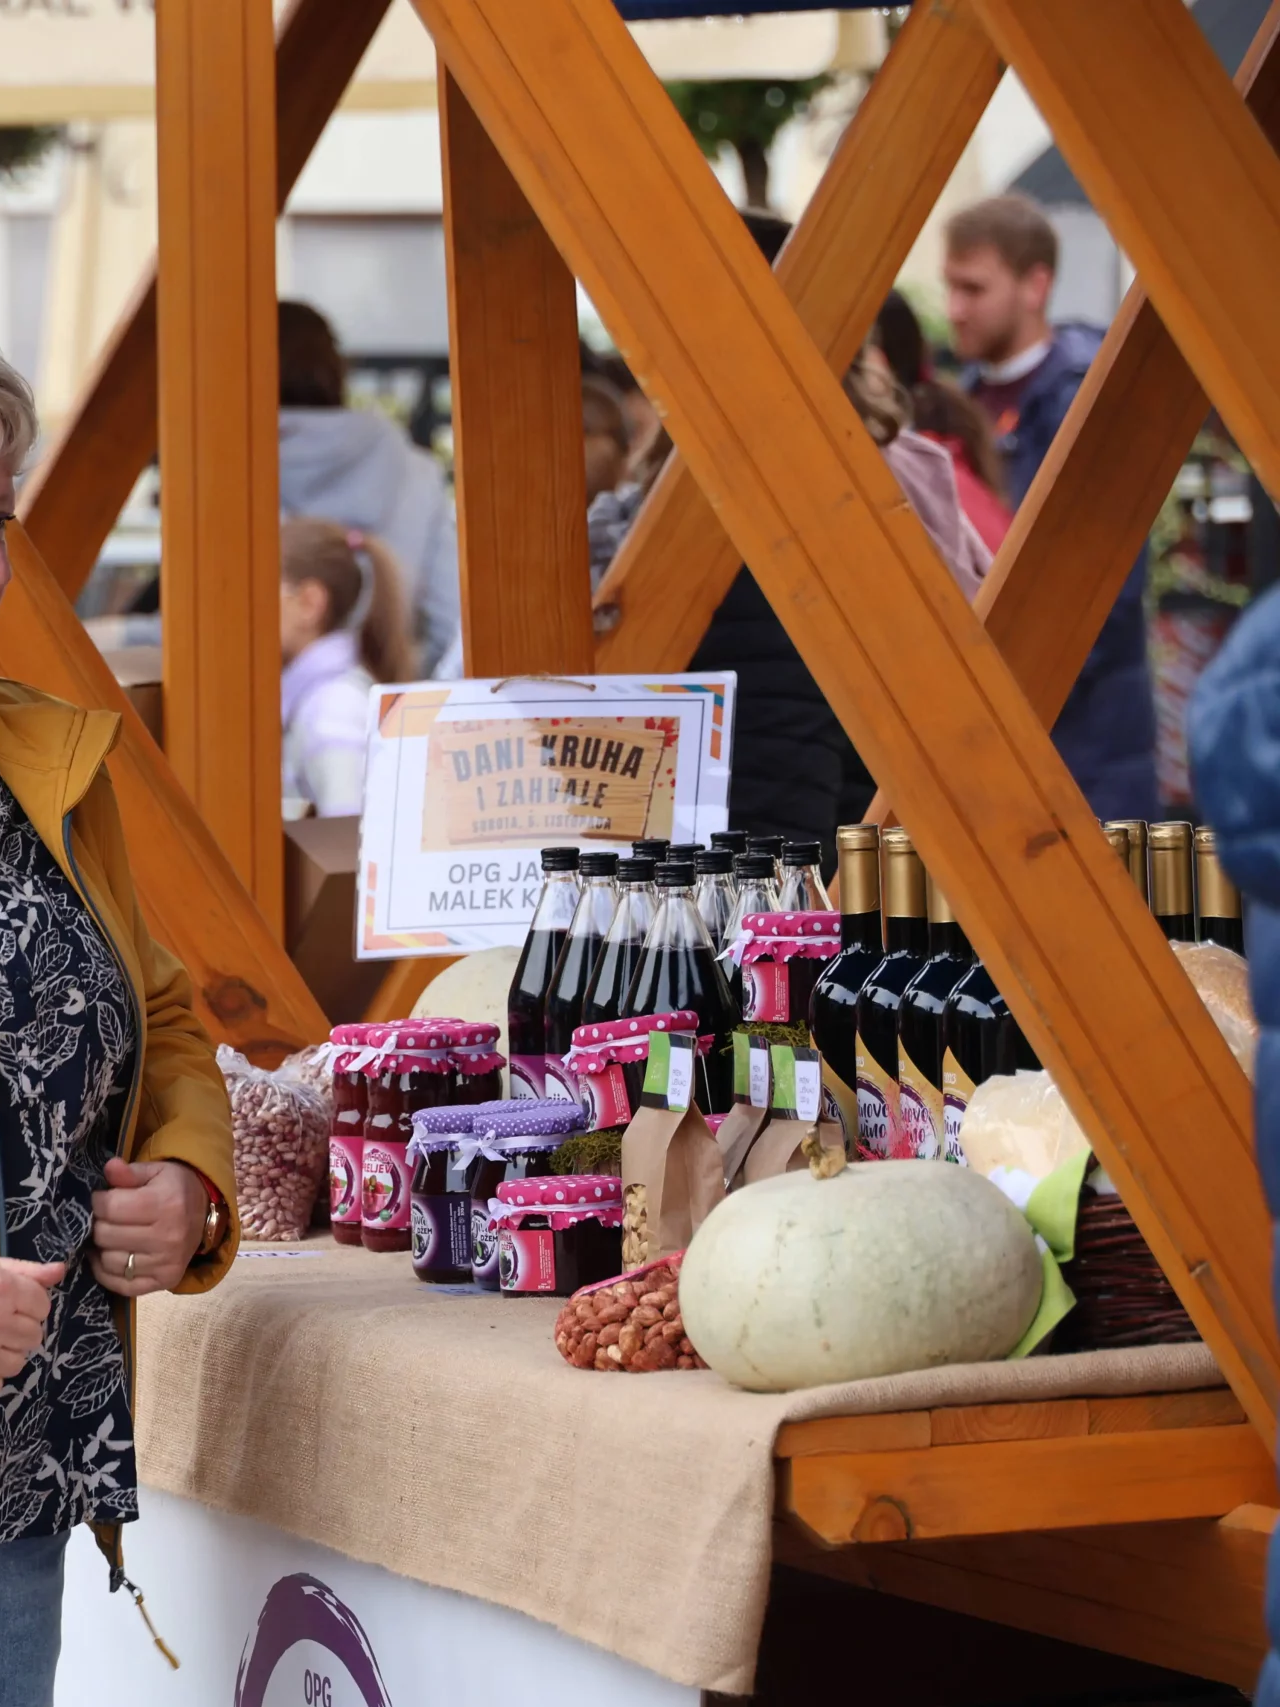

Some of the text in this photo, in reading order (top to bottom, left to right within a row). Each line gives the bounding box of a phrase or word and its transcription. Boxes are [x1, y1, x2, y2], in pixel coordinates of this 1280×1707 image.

[452, 735, 645, 782] DANI KRUHA
[476, 777, 608, 811] I ZAHVALE
[448, 861, 544, 884] OPG JA
[428, 888, 513, 912] MALEK
[417, 1226, 432, 1235] DŽEM
[481, 1233, 499, 1243] DŽEM
[304, 1669, 332, 1707] OPG
